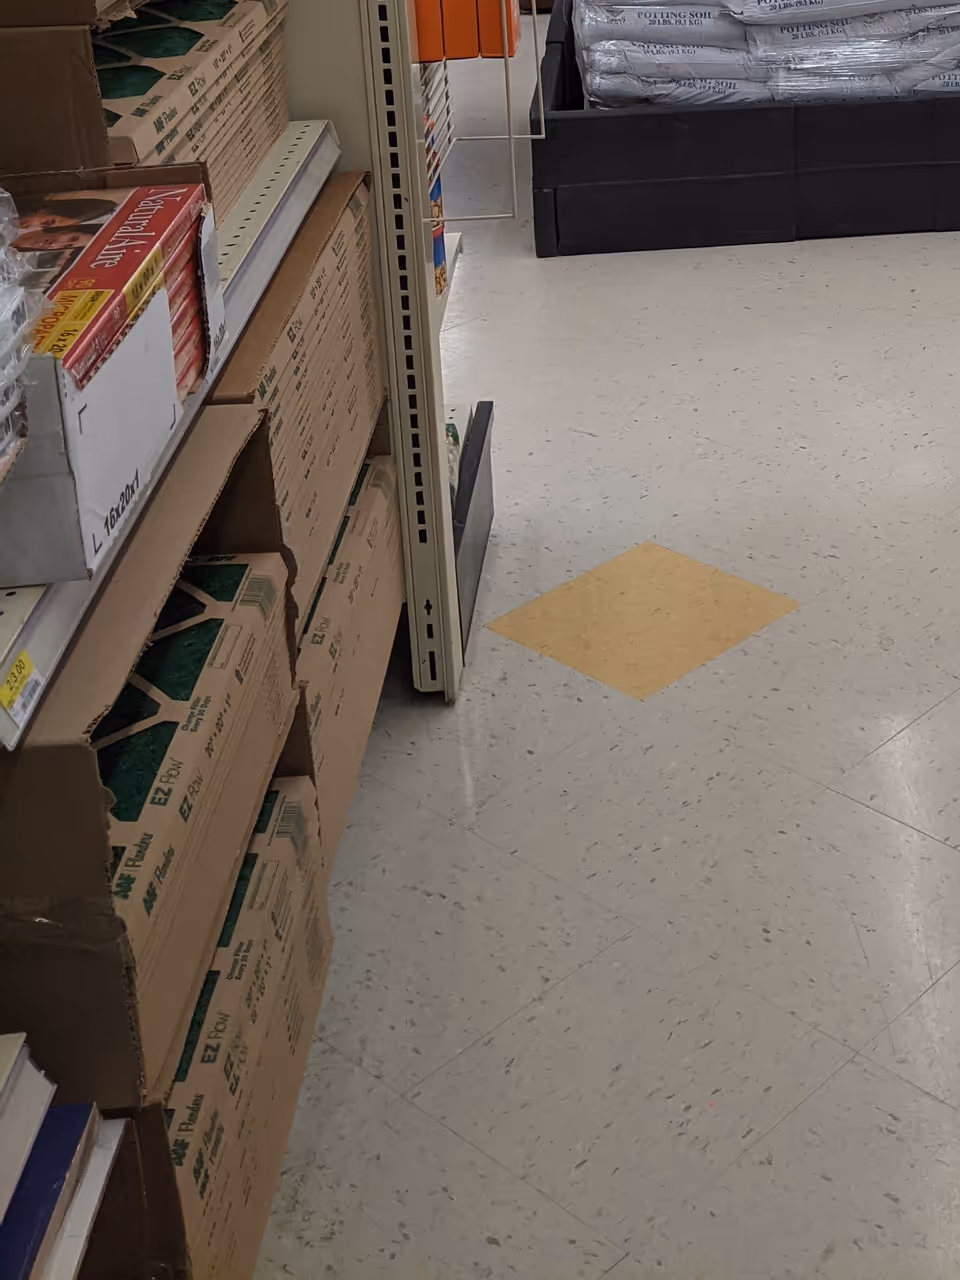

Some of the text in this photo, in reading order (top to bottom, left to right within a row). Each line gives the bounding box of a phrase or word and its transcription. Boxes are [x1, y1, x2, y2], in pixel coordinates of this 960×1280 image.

[637, 11, 714, 19] POTTING SOIL
[104, 468, 141, 538] 16x20x1
[6, 658, 26, 691] 2/3.00
[149, 785, 173, 808] EZ
[178, 794, 194, 823] EZ
[200, 1041, 220, 1065] EZ
